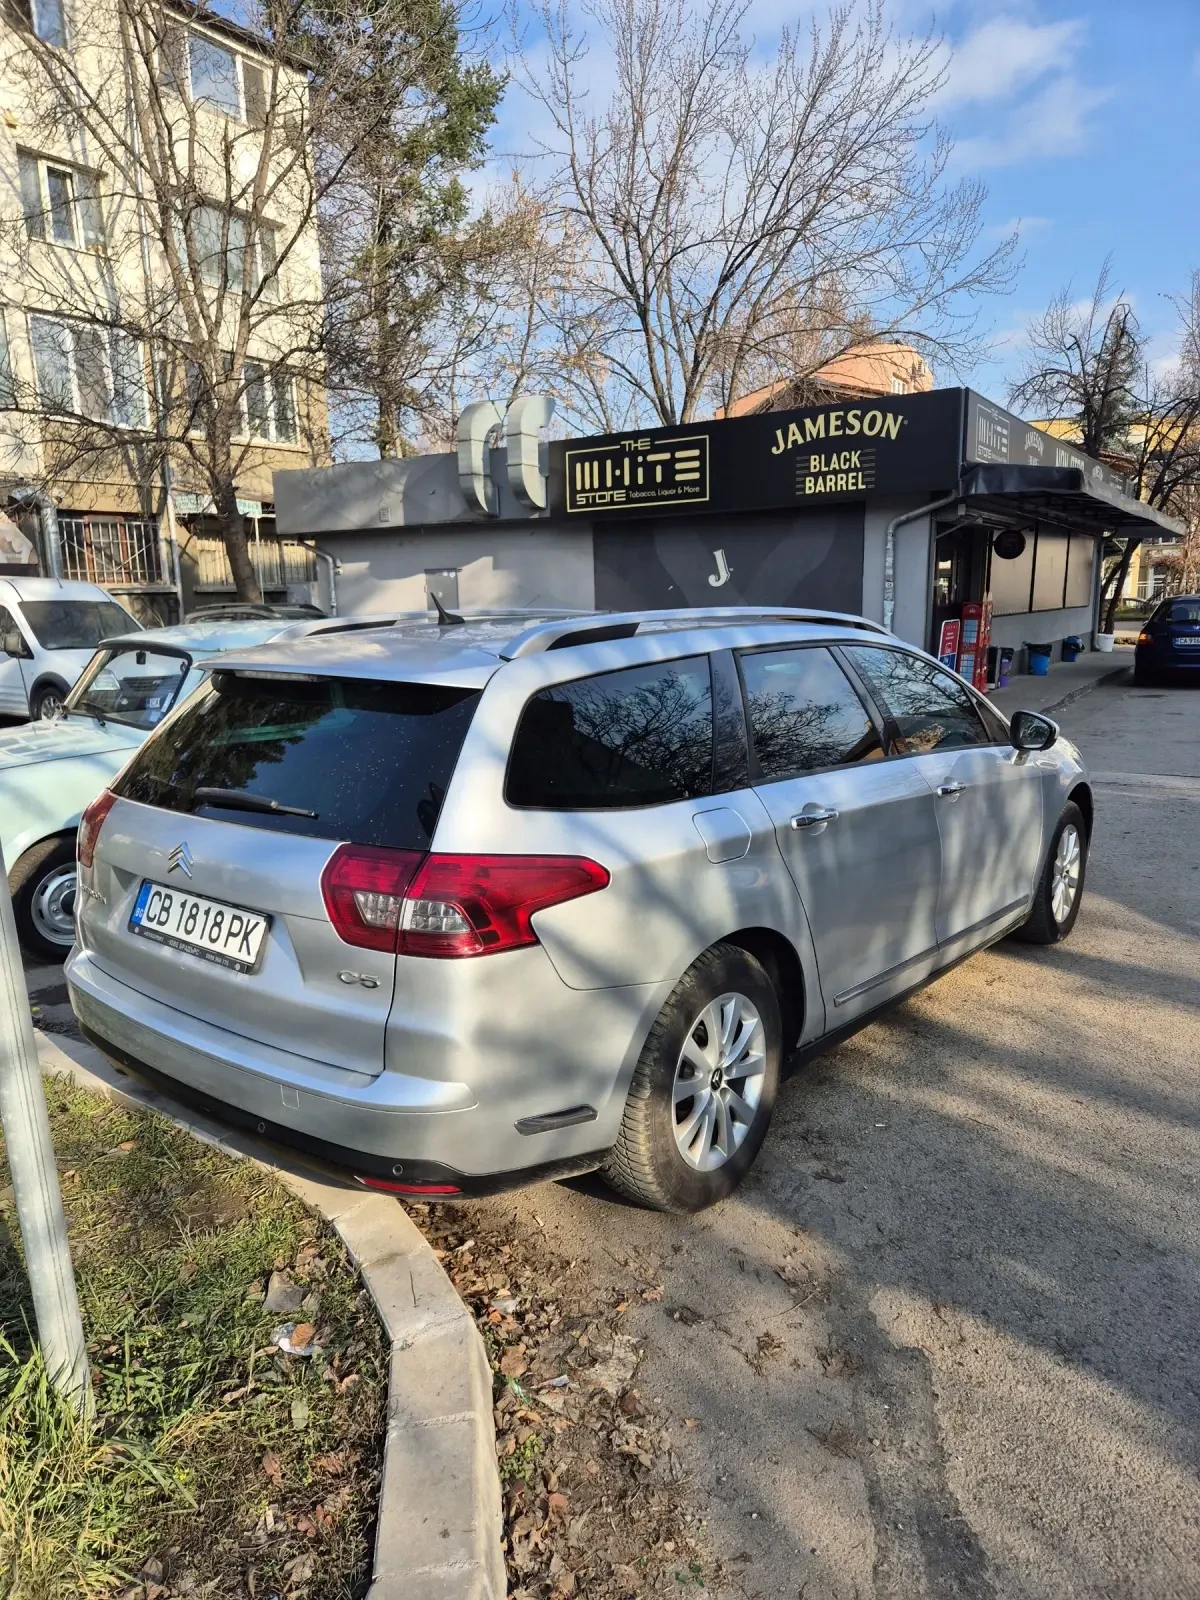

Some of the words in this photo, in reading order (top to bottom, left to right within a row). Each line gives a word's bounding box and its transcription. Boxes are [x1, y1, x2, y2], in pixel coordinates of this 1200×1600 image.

[770, 409, 904, 455] JAMESON
[620, 438, 651, 452] THE
[809, 450, 861, 473] BLACK
[658, 488, 676, 497] Liquor
[677, 486, 683, 494] &
[684, 485, 700, 494] More
[805, 471, 866, 494] BARREL
[576, 490, 626, 505] STORE
[146, 891, 173, 926] CB
[175, 899, 225, 944] 1818
[223, 914, 260, 956] PK
[336, 970, 380, 988] C5
